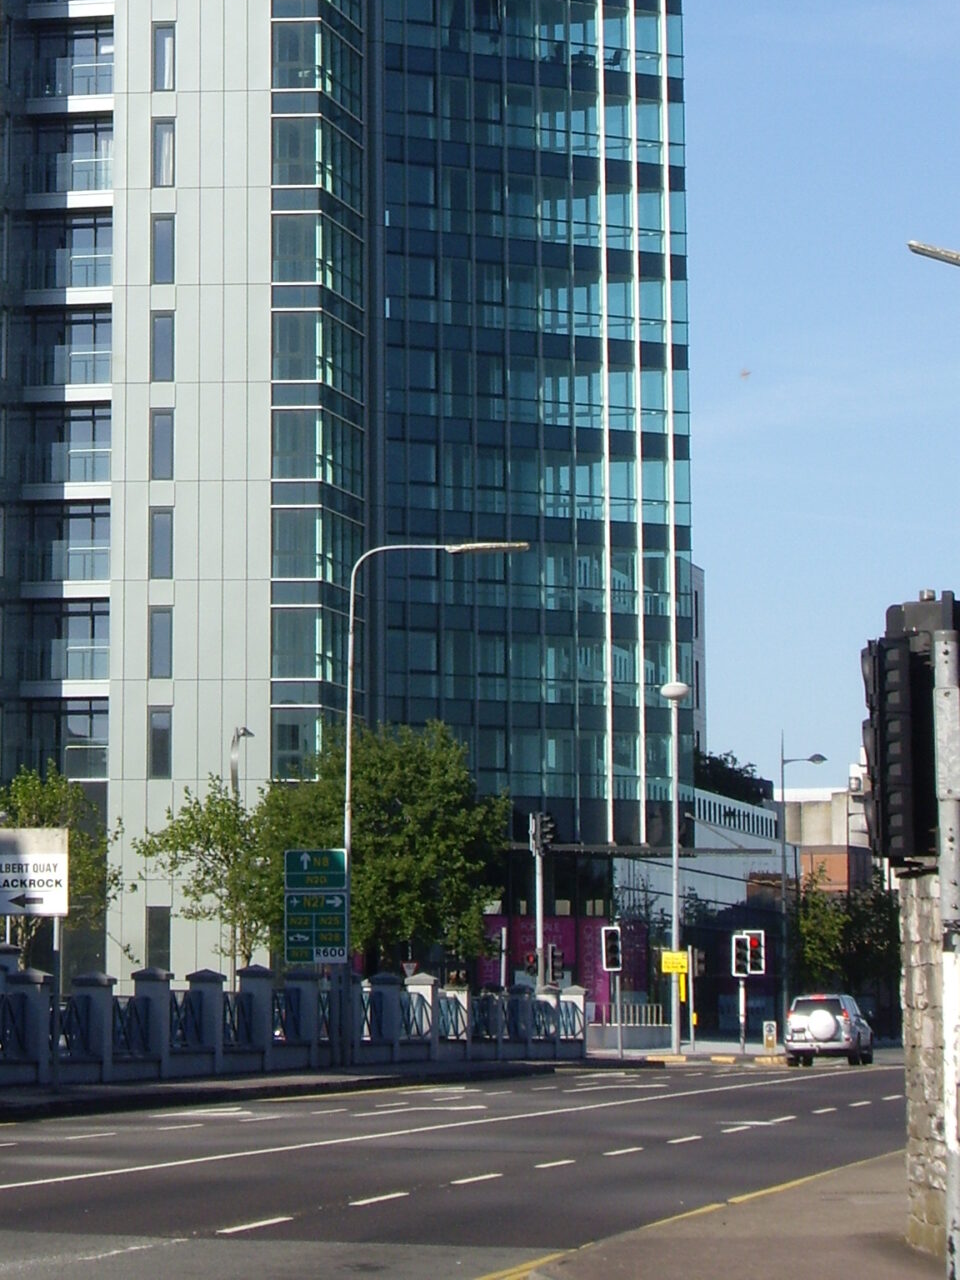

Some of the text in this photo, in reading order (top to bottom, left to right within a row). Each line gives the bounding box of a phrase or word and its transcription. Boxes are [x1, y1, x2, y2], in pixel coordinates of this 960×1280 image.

[32, 863, 58, 874] QUAY
[303, 896, 325, 908] N27
[315, 948, 345, 957] R600
